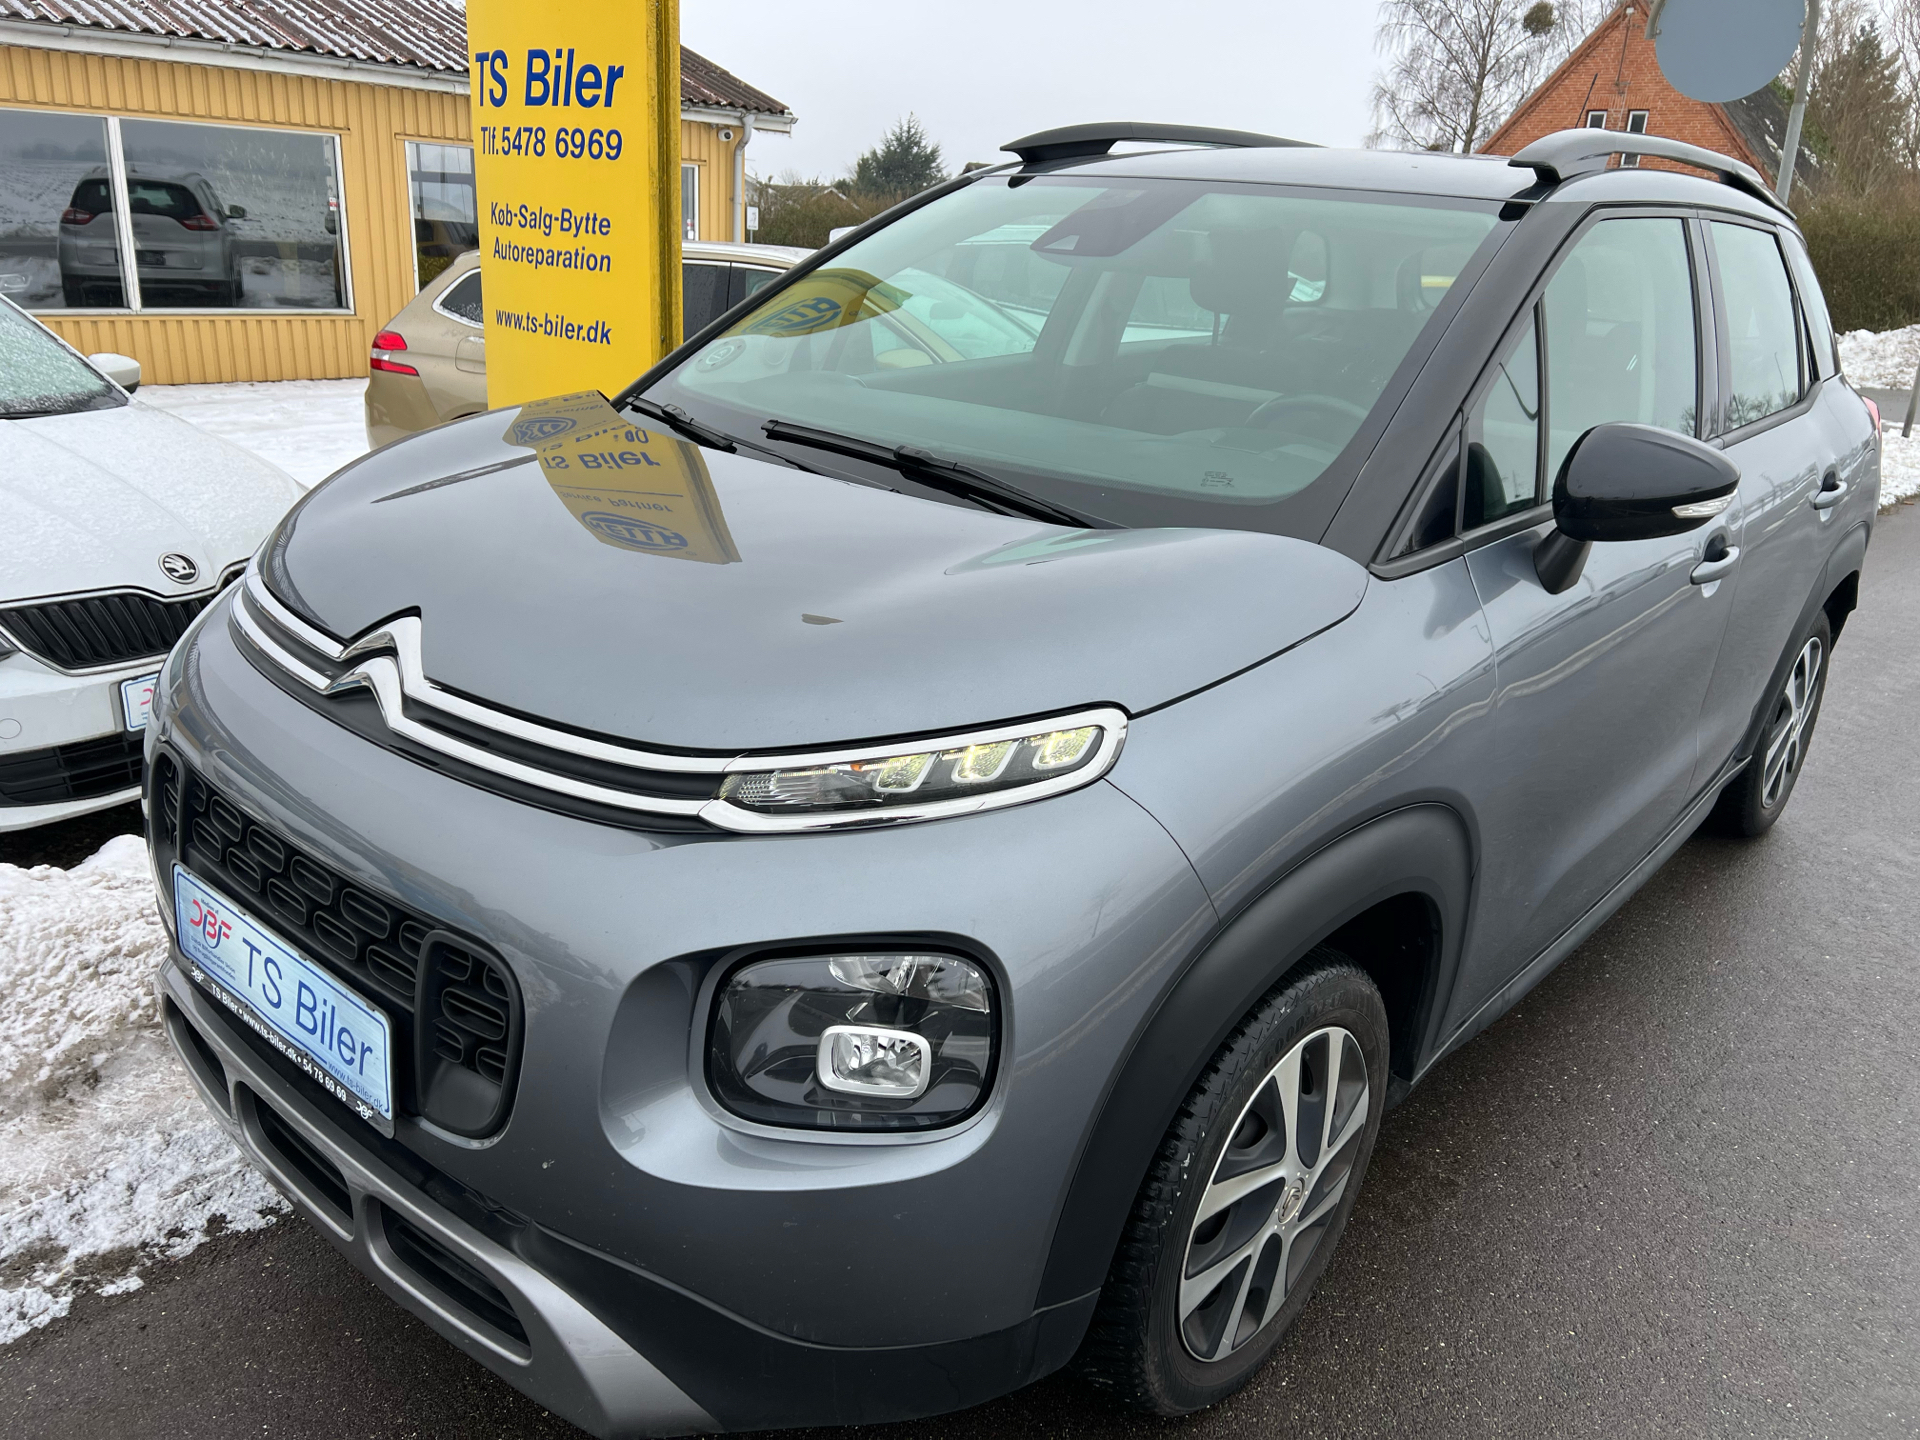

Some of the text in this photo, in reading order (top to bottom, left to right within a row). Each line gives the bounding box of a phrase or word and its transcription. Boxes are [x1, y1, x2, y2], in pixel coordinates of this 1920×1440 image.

[475, 48, 624, 108] TS Biler
[555, 127, 623, 160] 6969
[491, 201, 611, 238] Køb-Salg-Bytte
[493, 236, 611, 272] Autoreparation
[496, 309, 612, 345] www.ts-biler.dk
[243, 937, 282, 1009] TS
[296, 980, 373, 1076] Biler
[211, 983, 347, 1102] TS Biler www.ts-biler.dk 54 78 69 69
